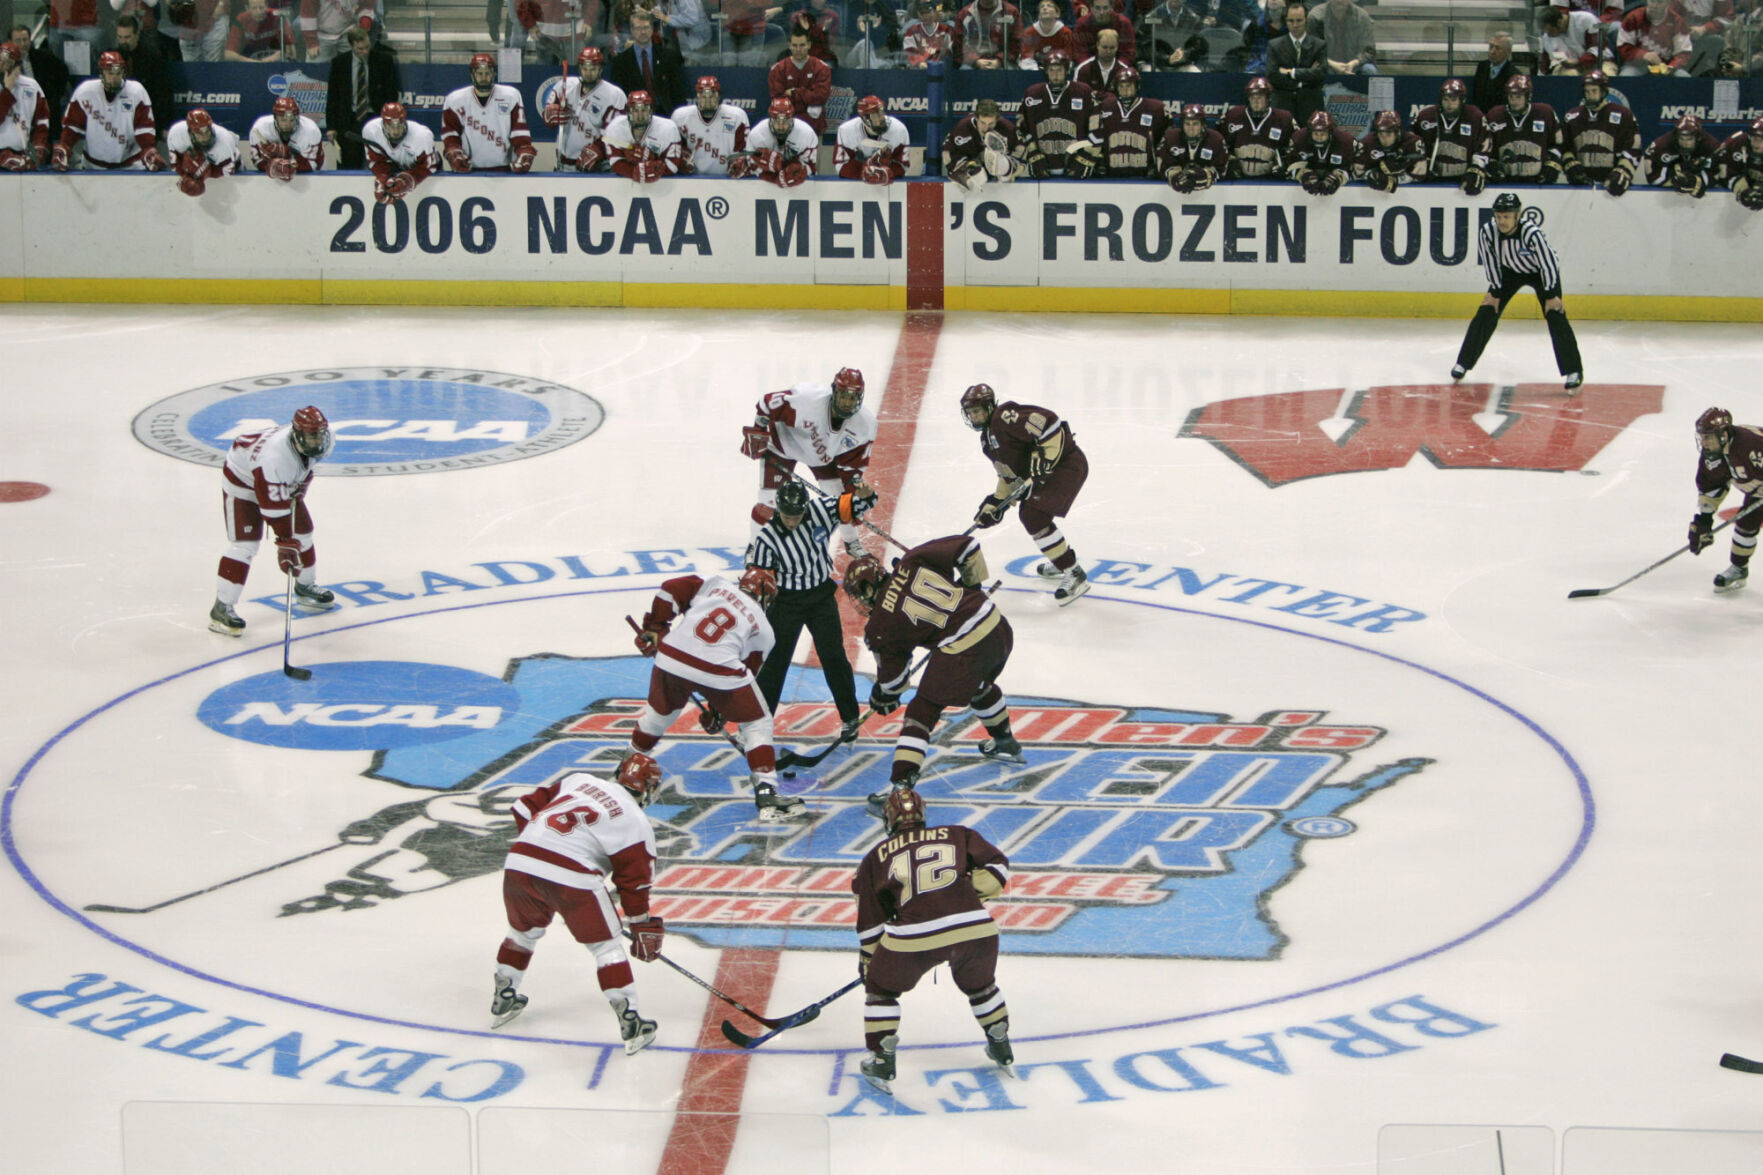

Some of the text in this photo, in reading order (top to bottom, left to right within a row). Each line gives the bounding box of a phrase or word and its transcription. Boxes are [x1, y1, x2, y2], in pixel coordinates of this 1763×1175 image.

[887, 97, 929, 111] NCAA
[1660, 106, 1706, 119] NCAA
[329, 196, 498, 254] 2006
[1043, 203, 1307, 264] FROZEN
[381, 369, 558, 395] YEARS
[881, 565, 910, 613] BOYLE
[901, 566, 963, 630] 10
[1004, 555, 1428, 633] CENTER
[694, 606, 737, 644] 8
[223, 701, 502, 729] NCAA
[574, 783, 624, 820] BURISH
[877, 828, 949, 863] COLLINS
[888, 843, 958, 906] 12
[15, 972, 526, 1103] CENTER
